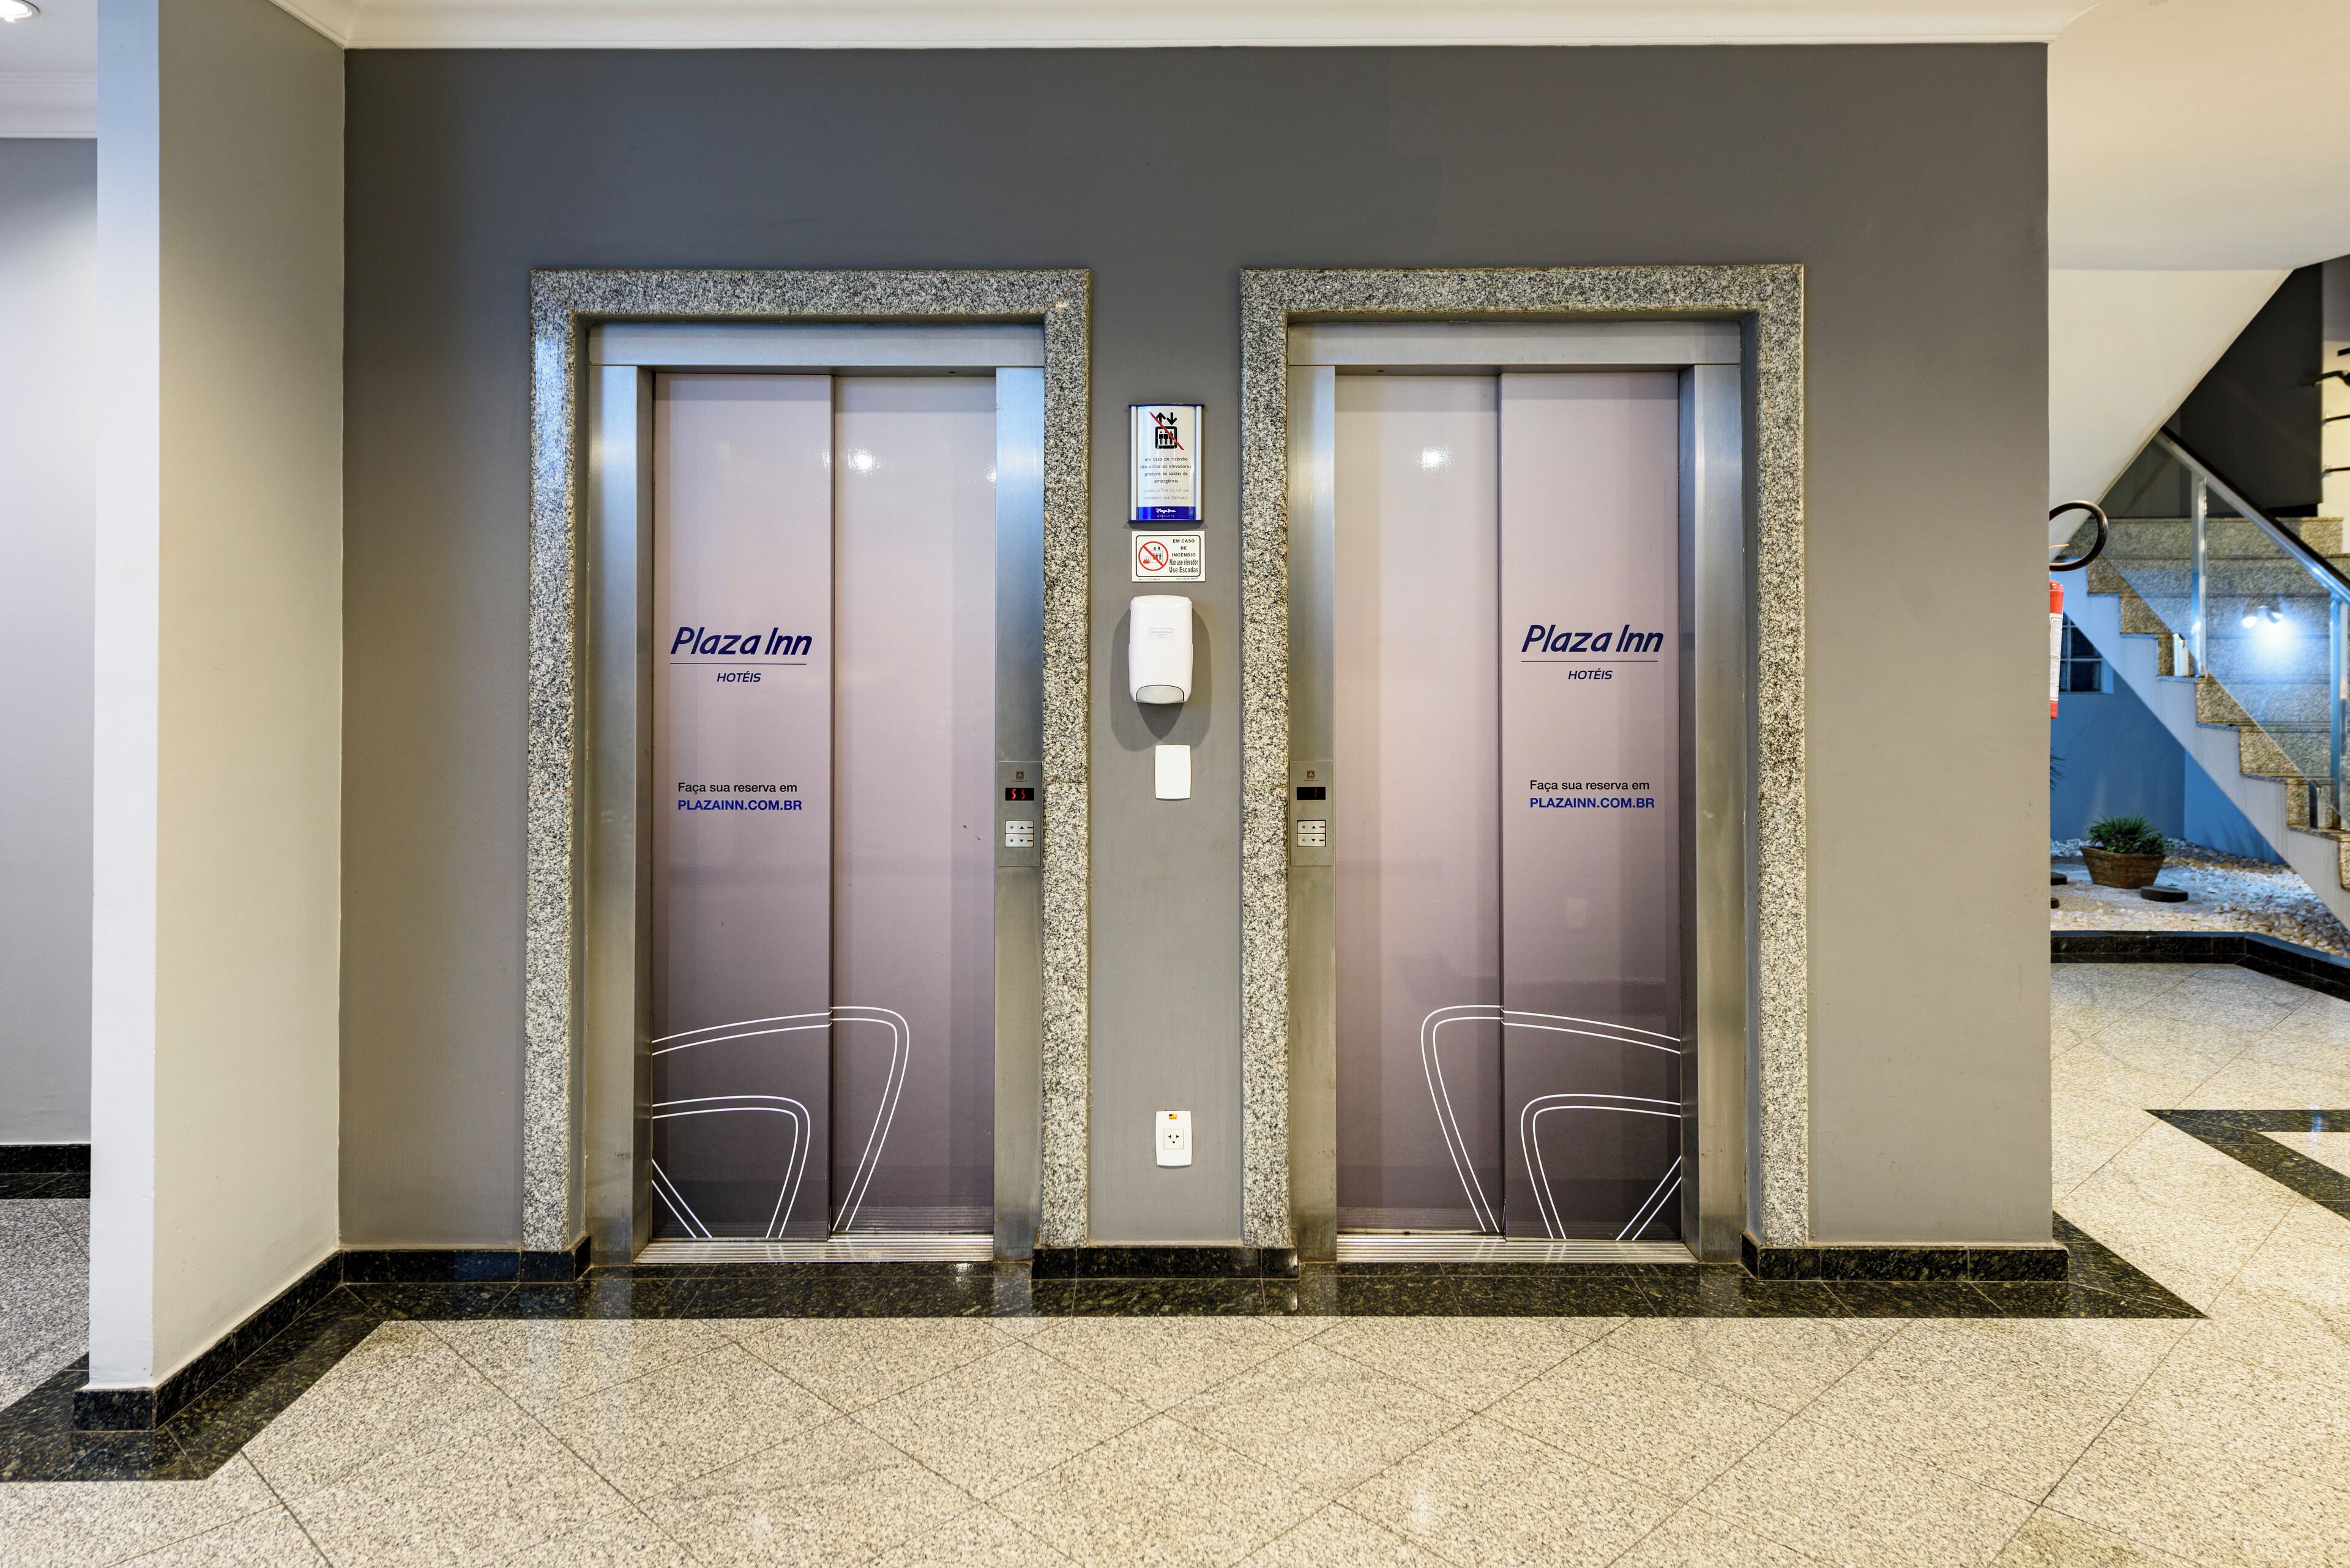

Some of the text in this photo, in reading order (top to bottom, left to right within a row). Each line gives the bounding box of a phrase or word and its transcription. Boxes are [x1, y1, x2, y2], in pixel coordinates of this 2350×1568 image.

[670, 627, 813, 655] Plaza Inn
[1521, 624, 1664, 652] Plaza Inn
[717, 671, 761, 682] HOTÉIS
[1568, 668, 1613, 680] HOTÉIS
[677, 782, 706, 795] Faça
[1530, 780, 1558, 793] Faça
[677, 799, 802, 811] PLAZAINN.COM.BR
[1530, 797, 1655, 808] PLAZAINN.COM.BR
